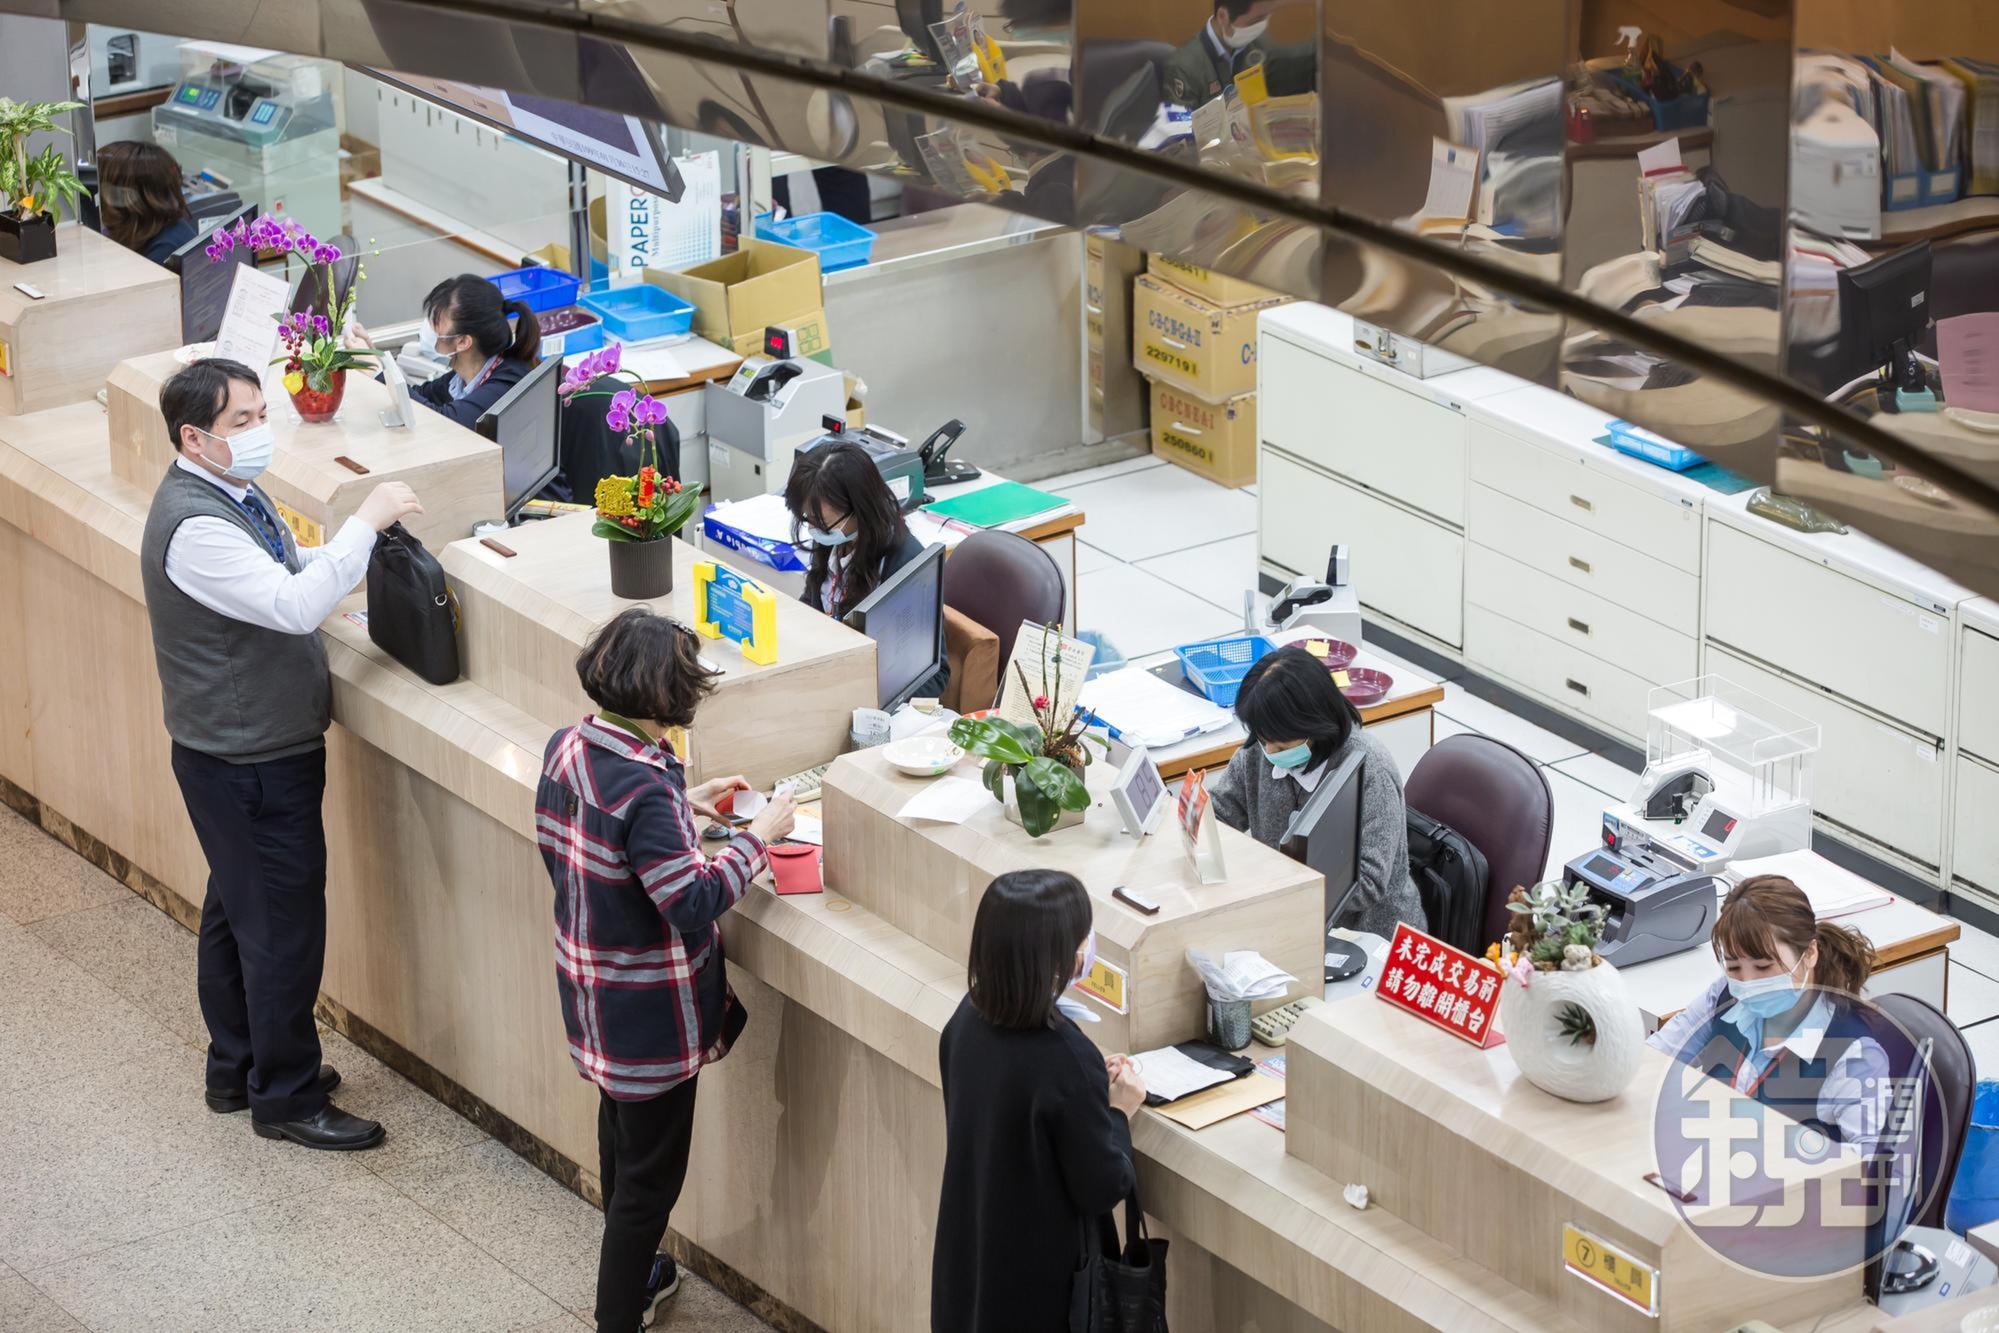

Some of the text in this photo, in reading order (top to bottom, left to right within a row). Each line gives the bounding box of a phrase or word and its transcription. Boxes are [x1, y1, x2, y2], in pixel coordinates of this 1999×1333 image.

[1385, 966, 1485, 1034] 請勿離開櫃台
[1396, 934, 1498, 1003] 未完成交易前
